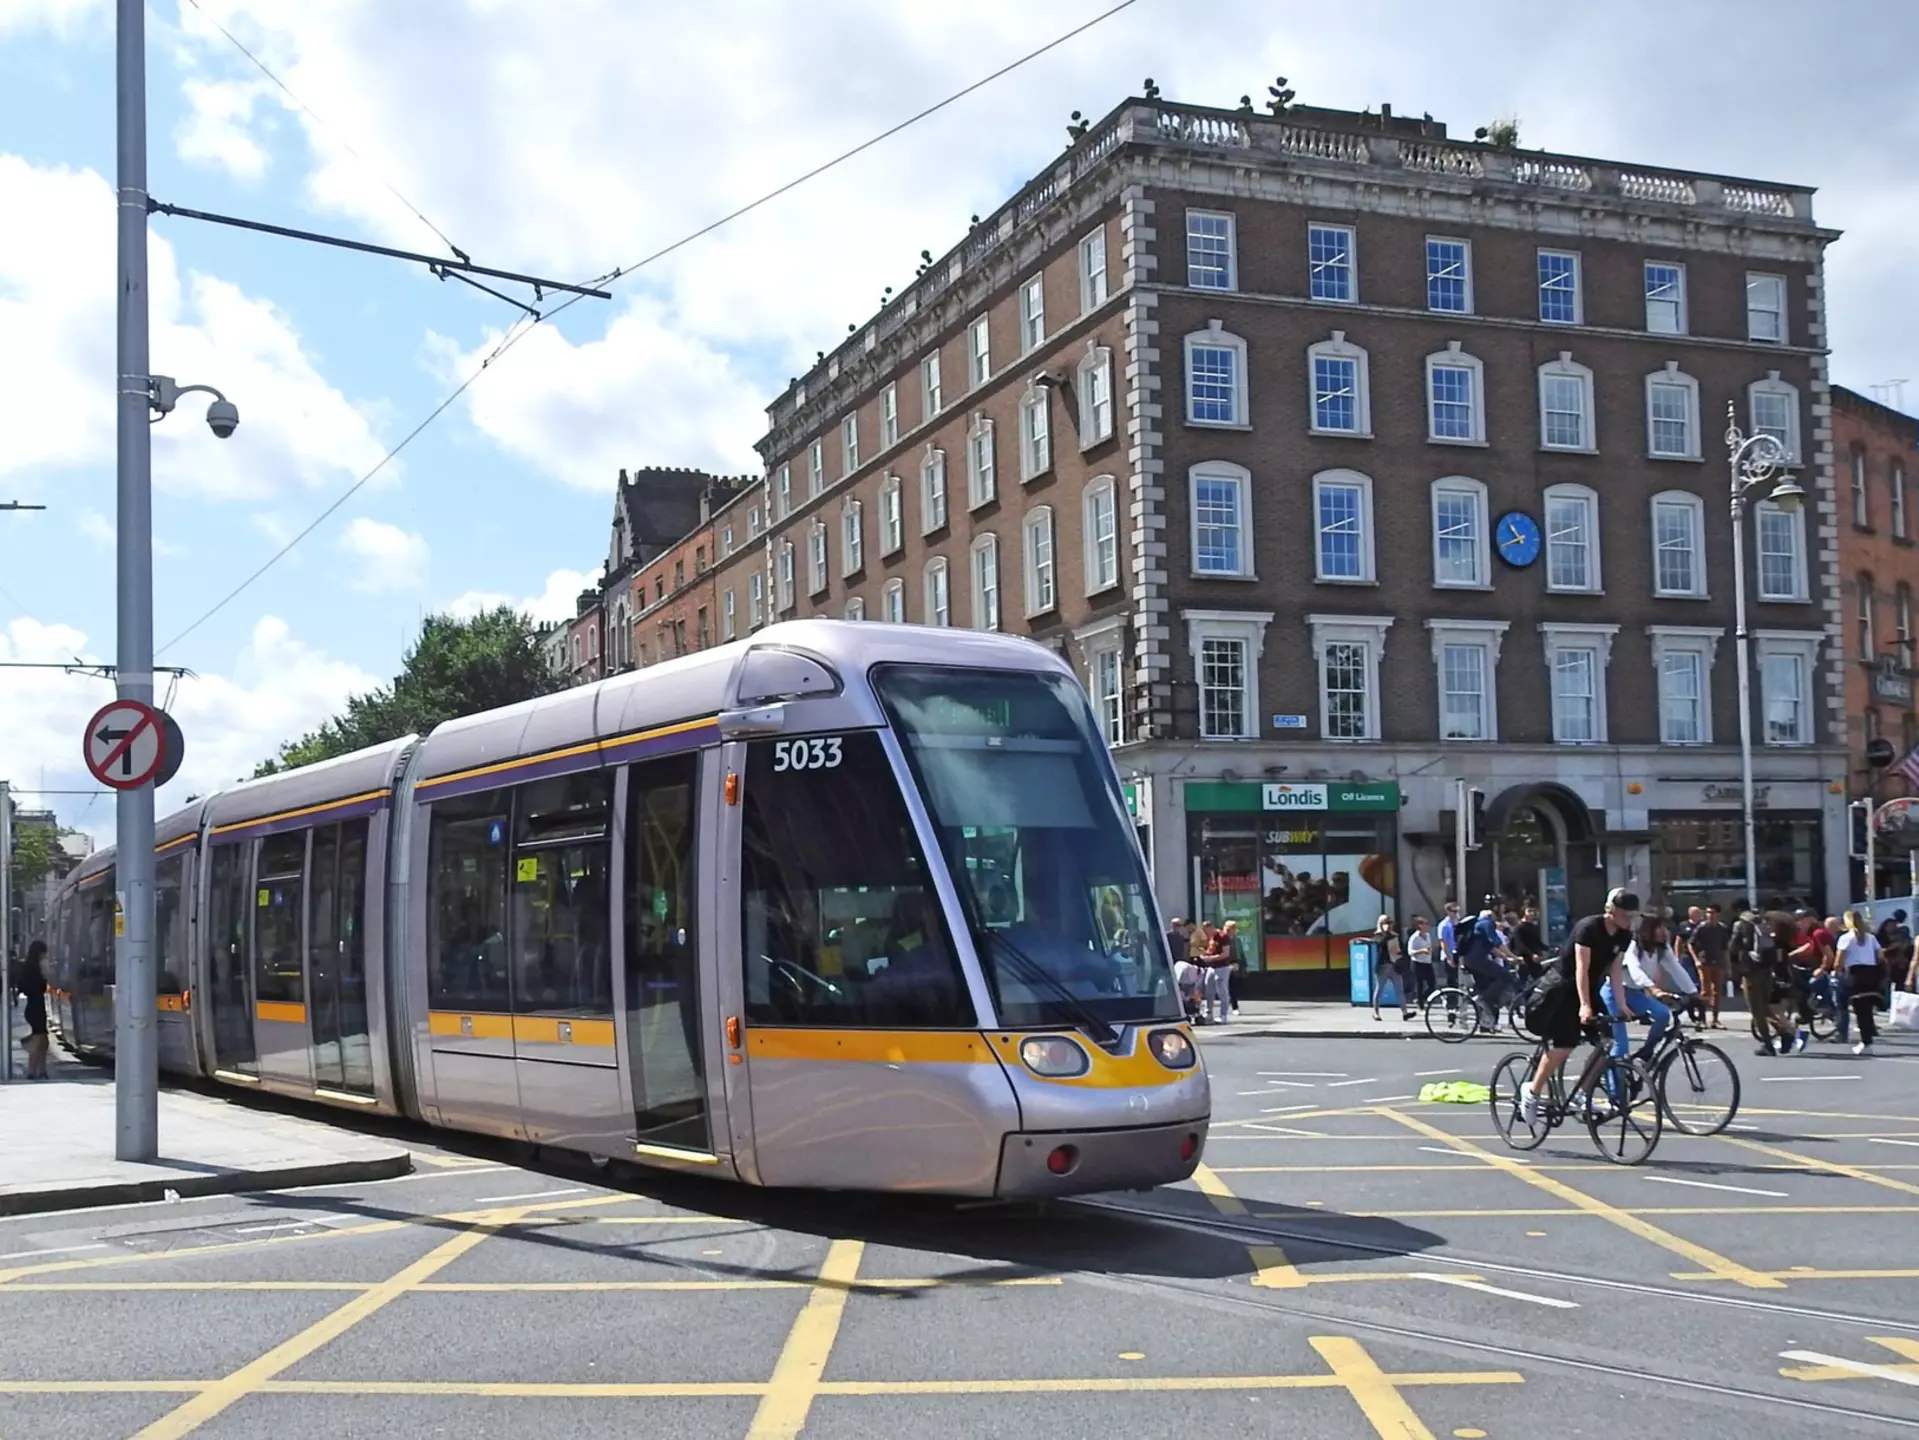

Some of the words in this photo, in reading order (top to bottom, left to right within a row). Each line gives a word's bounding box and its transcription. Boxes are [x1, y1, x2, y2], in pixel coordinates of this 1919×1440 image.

[774, 738, 843, 772] 5033
[1268, 789, 1323, 805] Londis
[1265, 830, 1317, 844] SUBWAY
